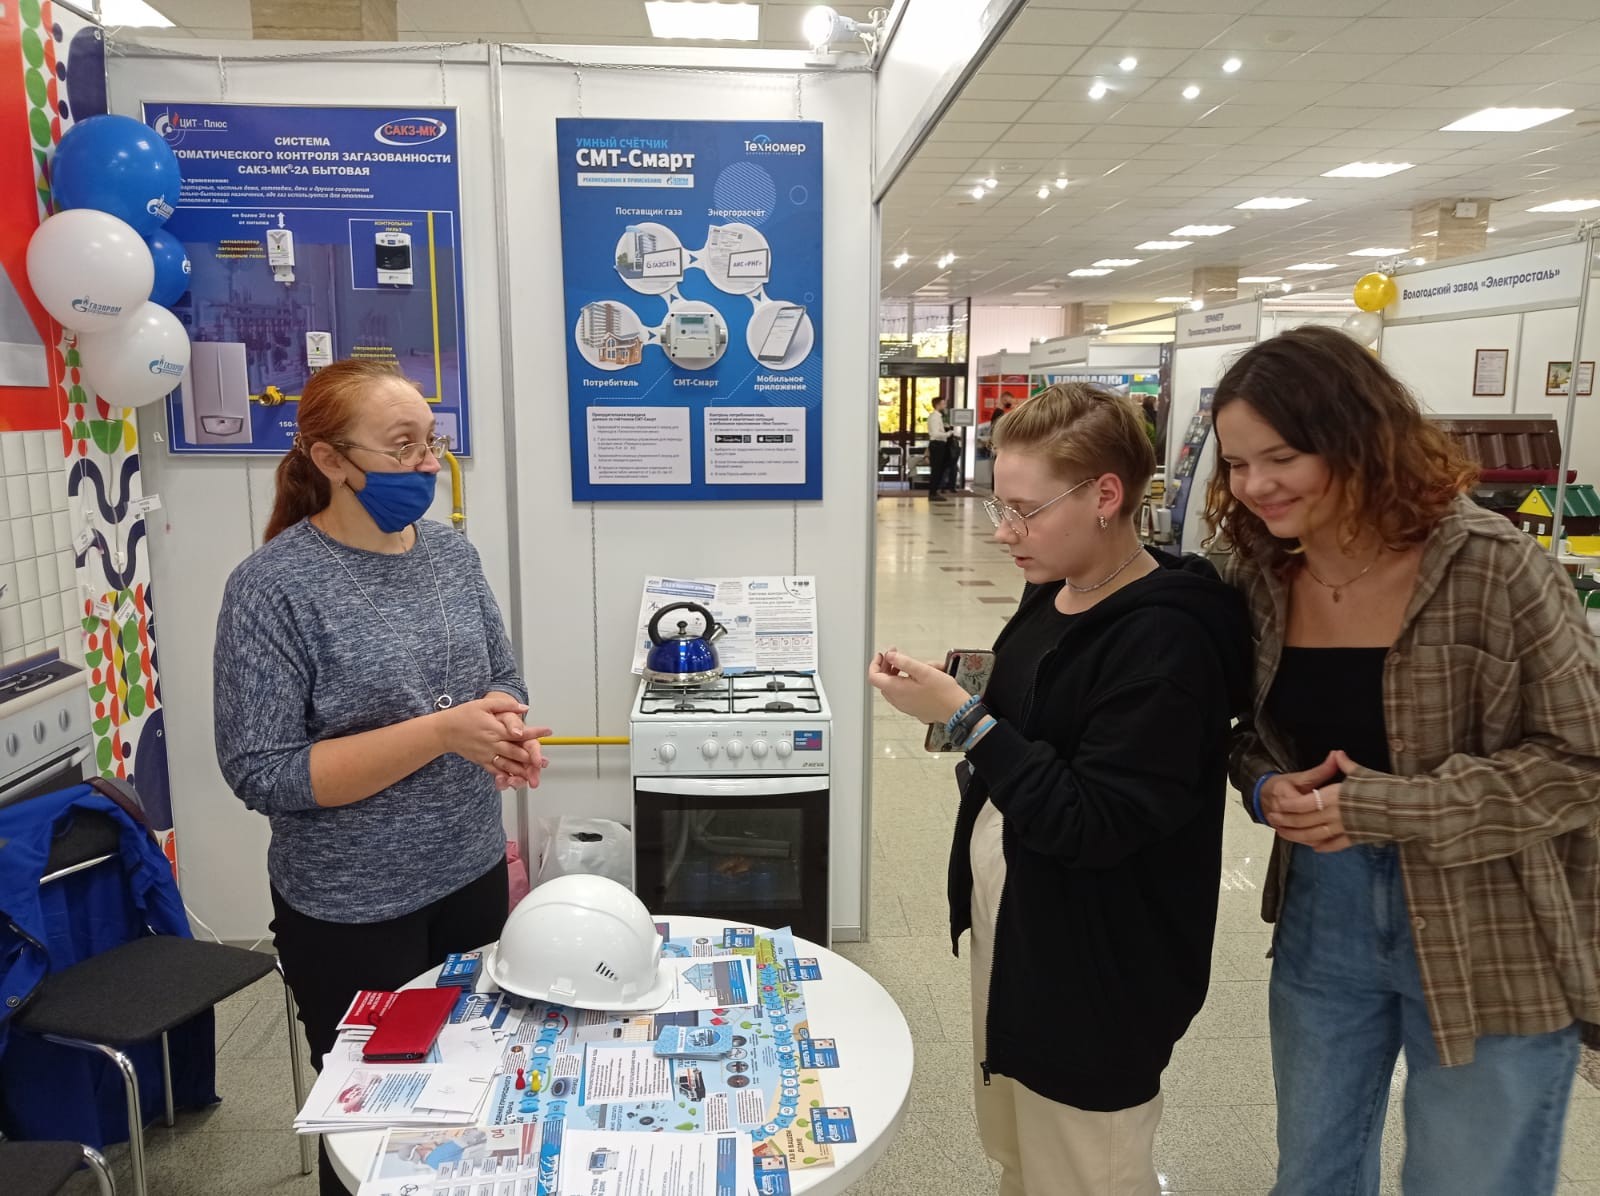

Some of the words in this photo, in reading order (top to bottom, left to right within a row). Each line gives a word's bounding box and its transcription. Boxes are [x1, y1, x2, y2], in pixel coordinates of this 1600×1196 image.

[180, 118, 198, 129] ЦИТ
[204, 119, 228, 129] Плюс
[384, 125, 437, 137] САКЗ-МК
[274, 136, 331, 147] СИСТЕМА
[576, 136, 617, 148] УМНЫЙ
[619, 137, 668, 149] СЧЁТЧИК
[743, 140, 806, 156] Техномер
[173, 149, 274, 160] ТОМАТИЧЕСКОГО
[276, 151, 339, 161] КОНТРОЛЯ
[342, 152, 452, 164] ЗАГАЗОВАННОСТИ
[576, 148, 696, 173] СМТ-Смарт
[312, 166, 370, 176] БЫТОВАЯ
[615, 207, 663, 217] Поставщик
[707, 208, 766, 218] Энергорасчёт
[1403, 283, 1451, 300] Вологодский
[1453, 280, 1479, 293] завод
[1481, 269, 1560, 289] «Электросталь»
[88, 302, 122, 313] ГАЗПРОМ
[583, 378, 639, 388] Потребитель
[673, 378, 719, 388] СМТ-Смарт
[756, 375, 804, 383] Мобильное
[754, 384, 807, 392] приложение
[490, 1129, 505, 1139] 04
[787, 1153, 796, 1163] ГАЗ
